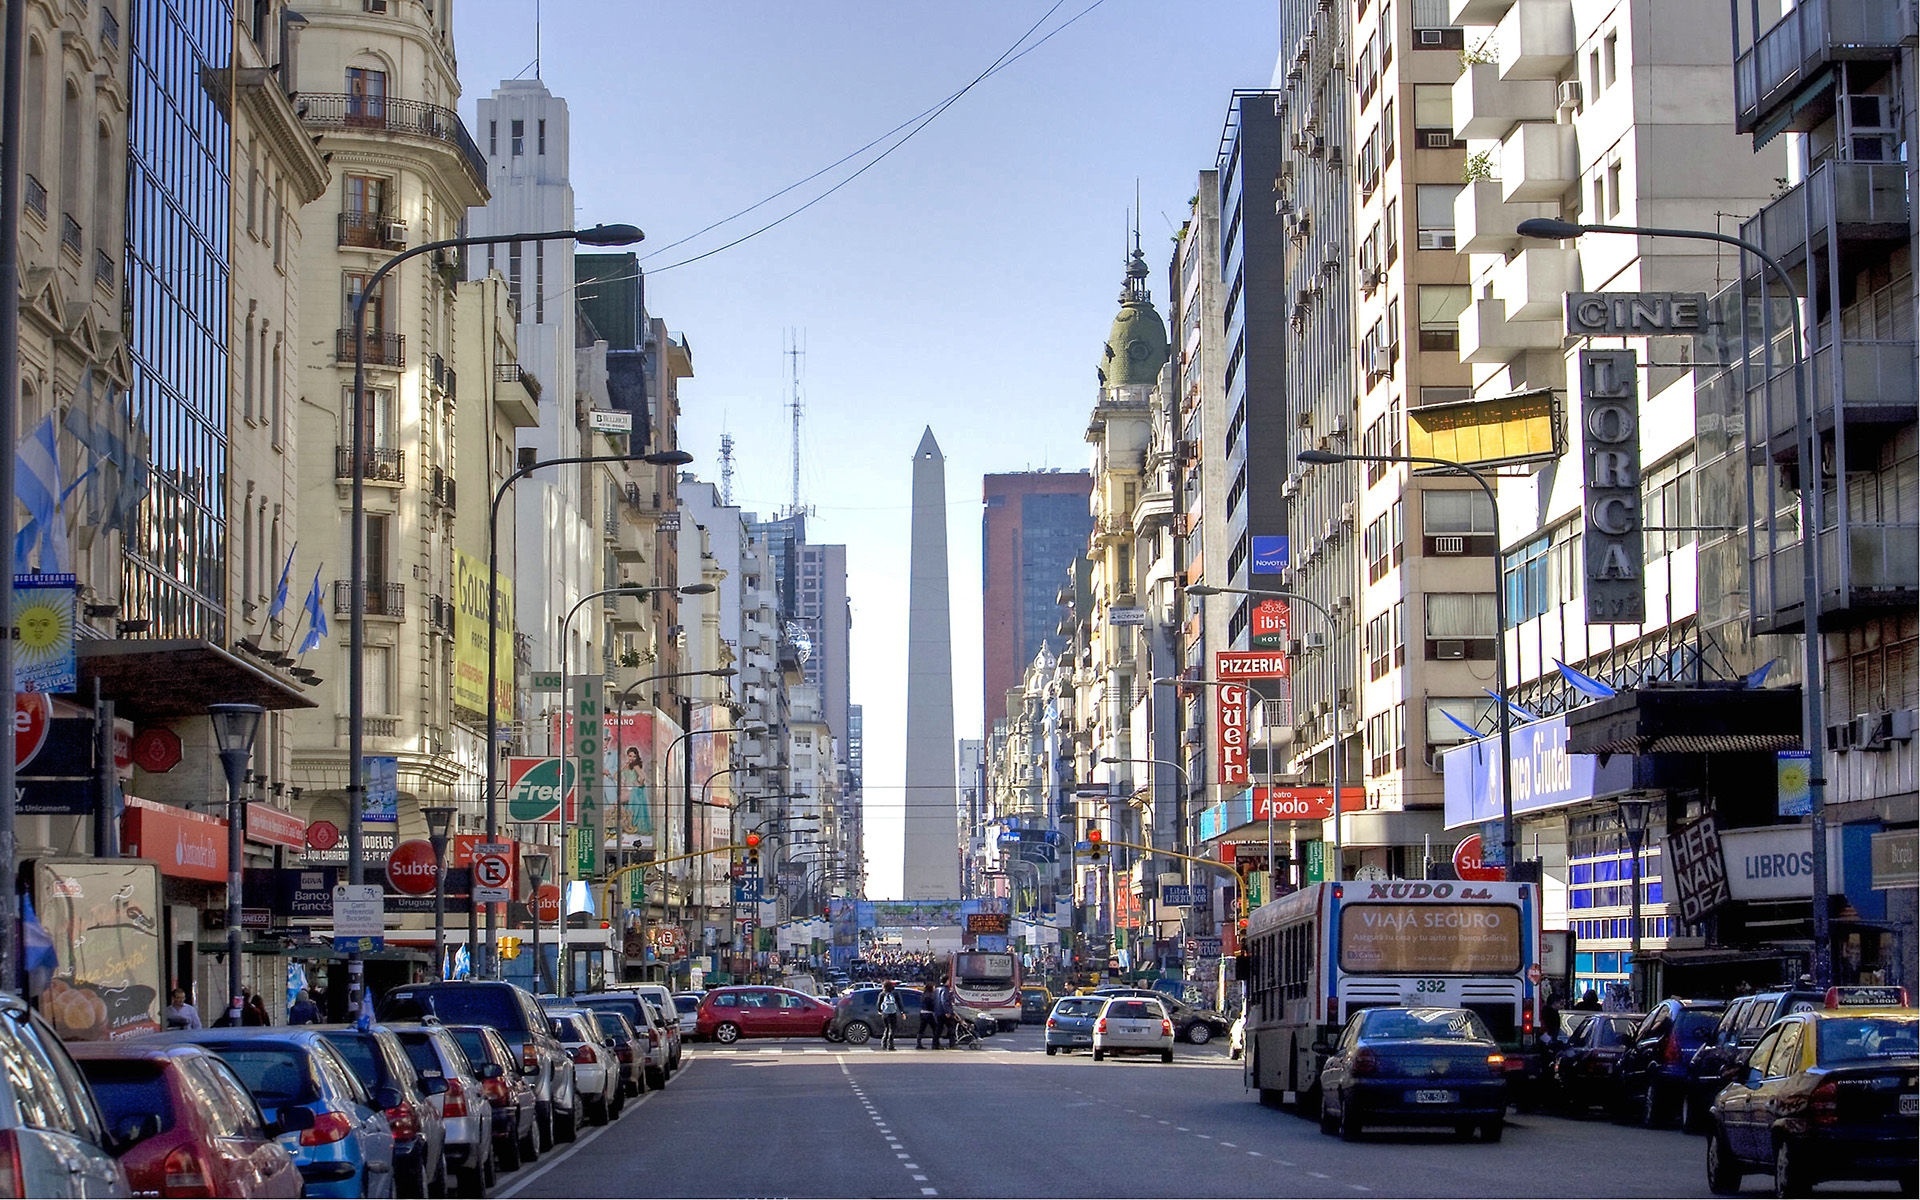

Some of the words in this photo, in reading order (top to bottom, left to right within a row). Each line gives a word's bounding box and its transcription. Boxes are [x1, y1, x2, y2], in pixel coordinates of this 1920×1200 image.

[1577, 298, 1699, 328] CINE
[1588, 357, 1638, 580] LORCA
[458, 555, 510, 635] GOLDSEIN
[1260, 616, 1287, 628] ibis
[1220, 658, 1284, 673] PIZZERIA
[535, 676, 561, 687] LOS
[1220, 685, 1243, 783] Güerr
[1511, 756, 1530, 801] nco
[1533, 728, 1572, 795] Ciudad
[509, 781, 560, 800] Free
[1260, 796, 1309, 818] Apolo
[362, 836, 394, 849] ODELOS
[1672, 822, 1718, 869] HER
[321, 850, 349, 861] CORRIENT
[392, 862, 438, 876] Subte
[1746, 852, 1813, 880] LIBROS
[1678, 856, 1723, 898] NAN
[295, 890, 329, 900] Banco
[1166, 894, 1206, 903] LIBERTDOR
[1368, 884, 1454, 899] NUDO
[292, 901, 333, 911] Francés
[398, 900, 436, 908] Uruguay
[538, 898, 560, 908] ubte
[1683, 881, 1728, 921] DEZ
[1362, 909, 1418, 931] VIAJÁ
[1424, 913, 1500, 928] SEGURO
[1416, 980, 1446, 992] 332
